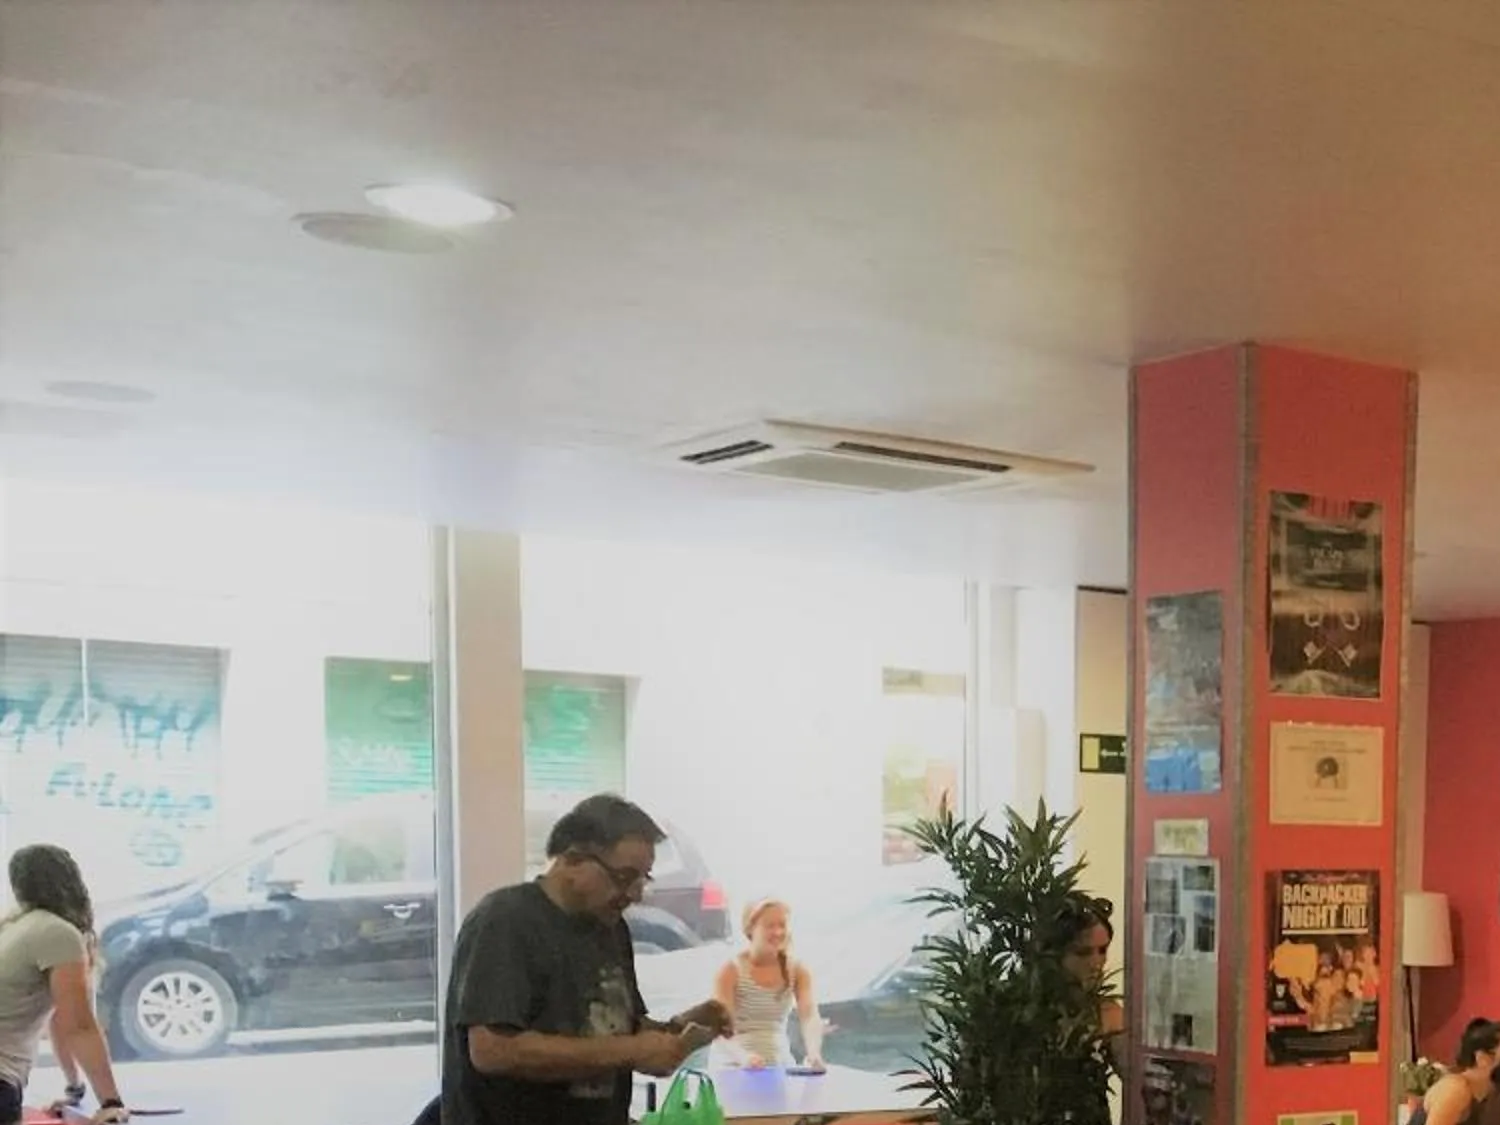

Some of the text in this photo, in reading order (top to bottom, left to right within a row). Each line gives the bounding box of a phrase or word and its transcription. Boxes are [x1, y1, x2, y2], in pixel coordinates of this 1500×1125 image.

[1283, 883, 1368, 904] BACKPACKER
[1282, 904, 1367, 928] NIGHT OUT
